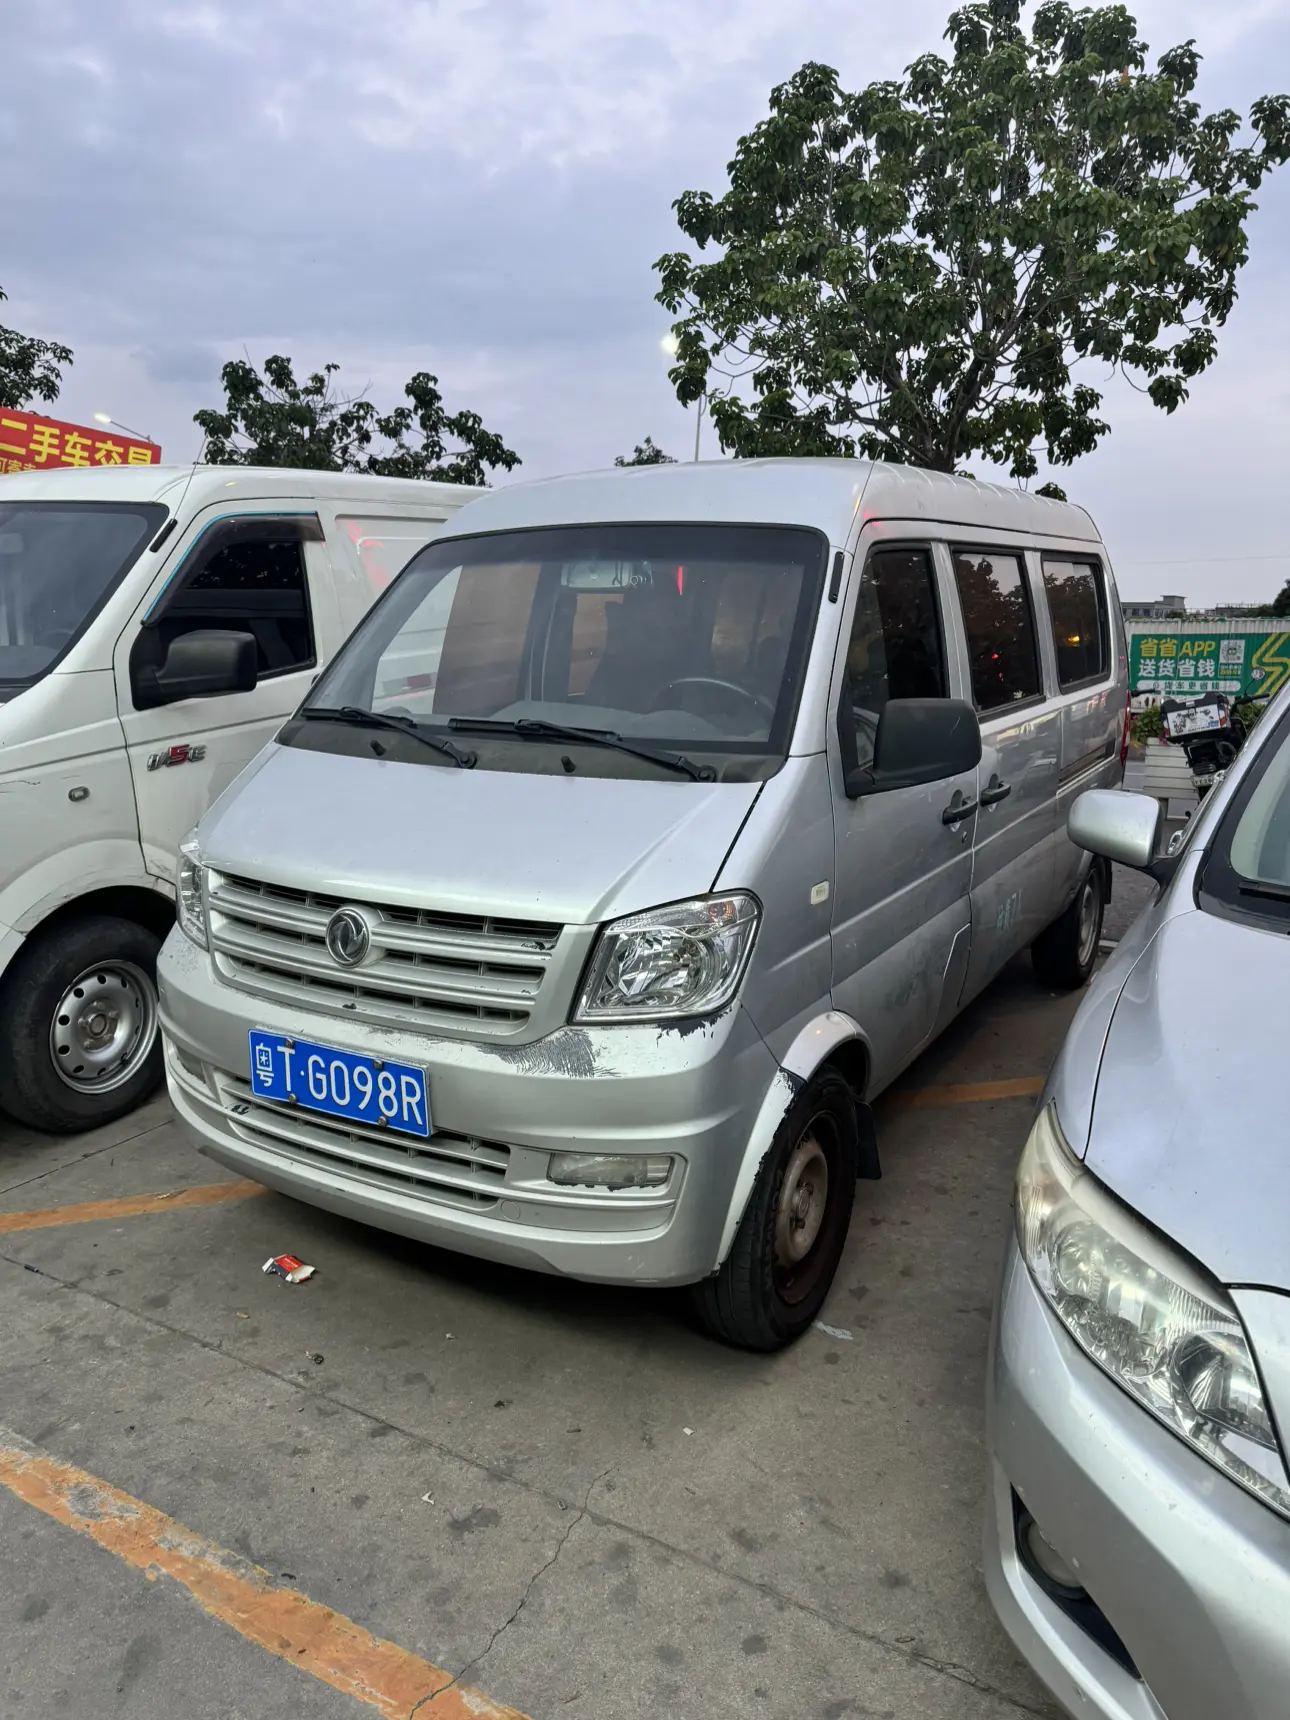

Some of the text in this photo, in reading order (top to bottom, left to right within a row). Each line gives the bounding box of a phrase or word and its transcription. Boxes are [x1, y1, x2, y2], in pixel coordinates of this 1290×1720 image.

[1140, 637, 1216, 657] 省省APP
[1138, 659, 1215, 678] 送货省钱
